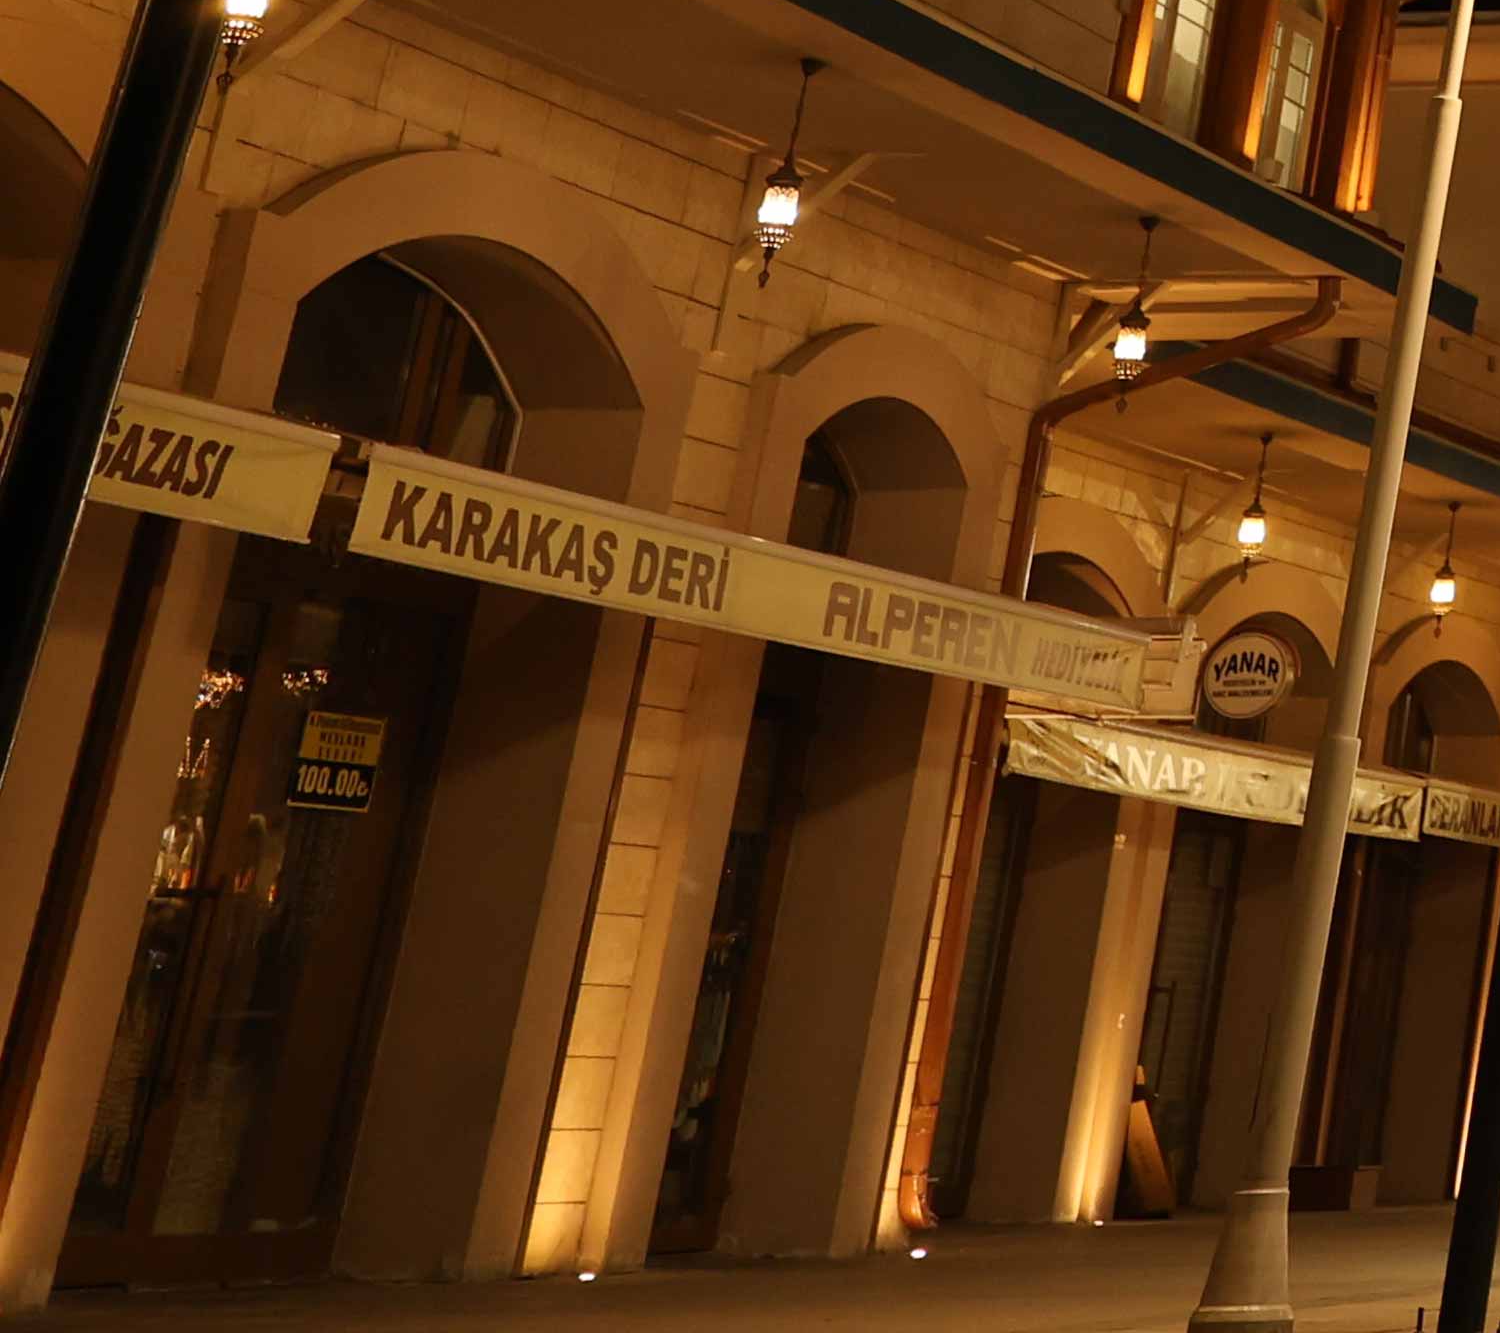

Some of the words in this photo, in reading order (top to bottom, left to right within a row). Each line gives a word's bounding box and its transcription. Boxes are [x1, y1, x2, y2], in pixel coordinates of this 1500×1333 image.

[380, 480, 619, 596] KARAKAŞ
[627, 537, 732, 613] DERİ
[821, 581, 1022, 679] ALPEREN
[1213, 650, 1281, 684] YANAR
